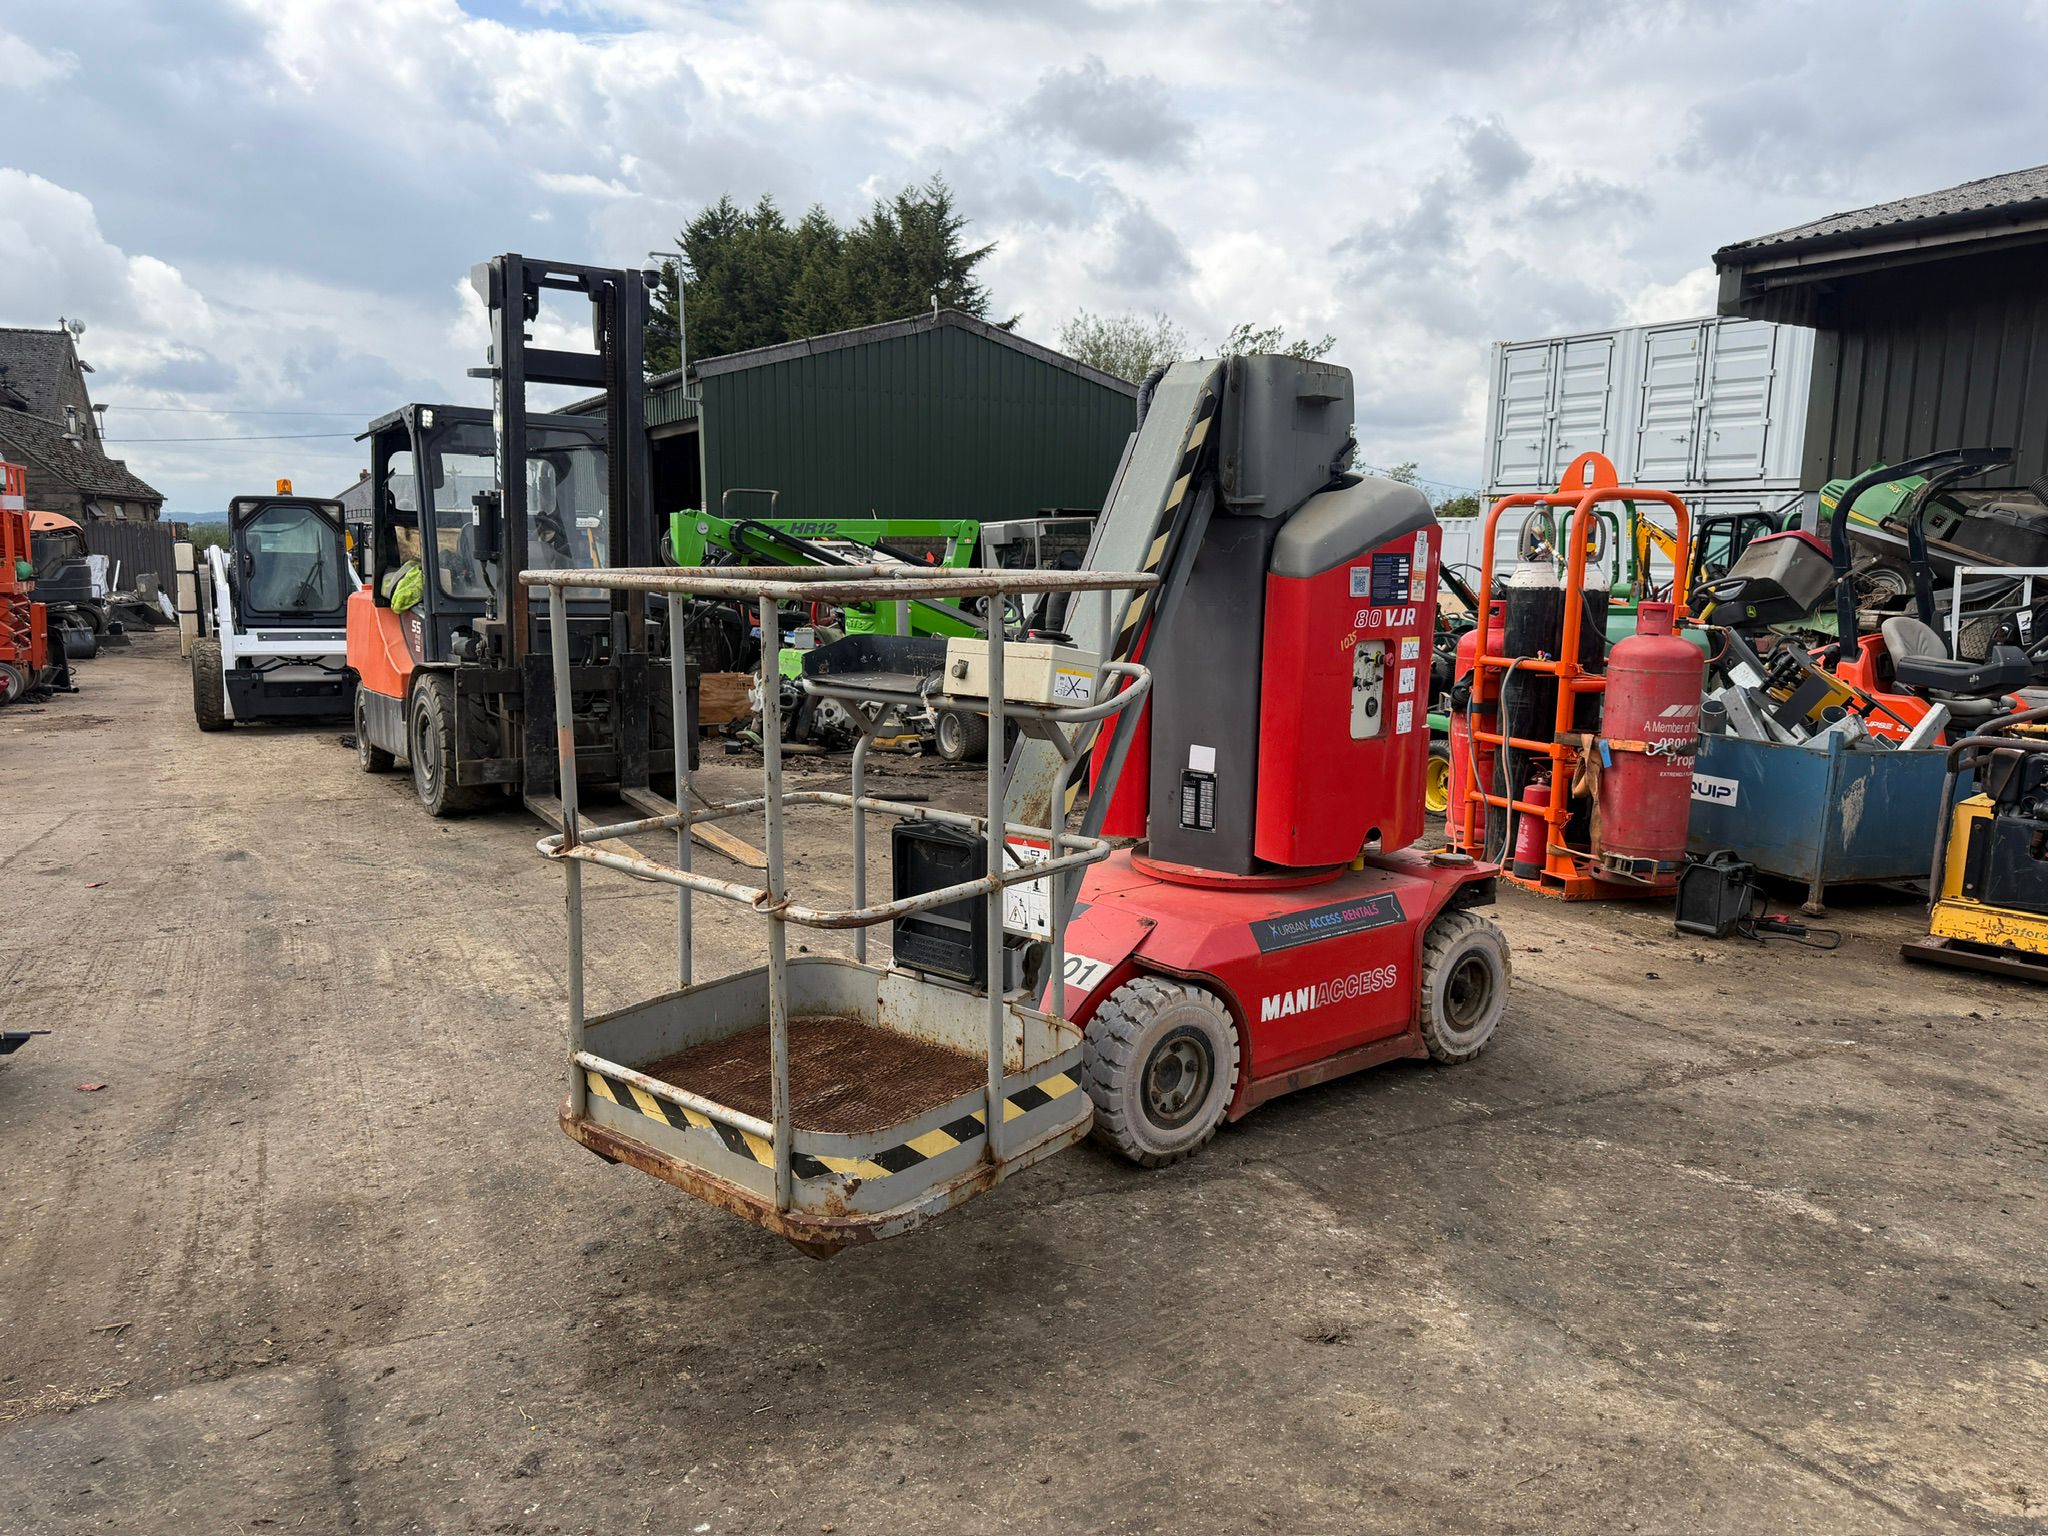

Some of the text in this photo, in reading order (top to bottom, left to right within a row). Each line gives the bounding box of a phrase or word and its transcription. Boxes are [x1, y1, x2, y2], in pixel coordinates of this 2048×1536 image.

[789, 522, 838, 534] HR12
[1353, 608, 1416, 628] 80 VJR
[411, 619, 422, 634] 55
[1643, 720, 1651, 732] A
[1652, 721, 1684, 734] Member
[1684, 721, 1691, 733] of
[1063, 957, 1098, 986] 01
